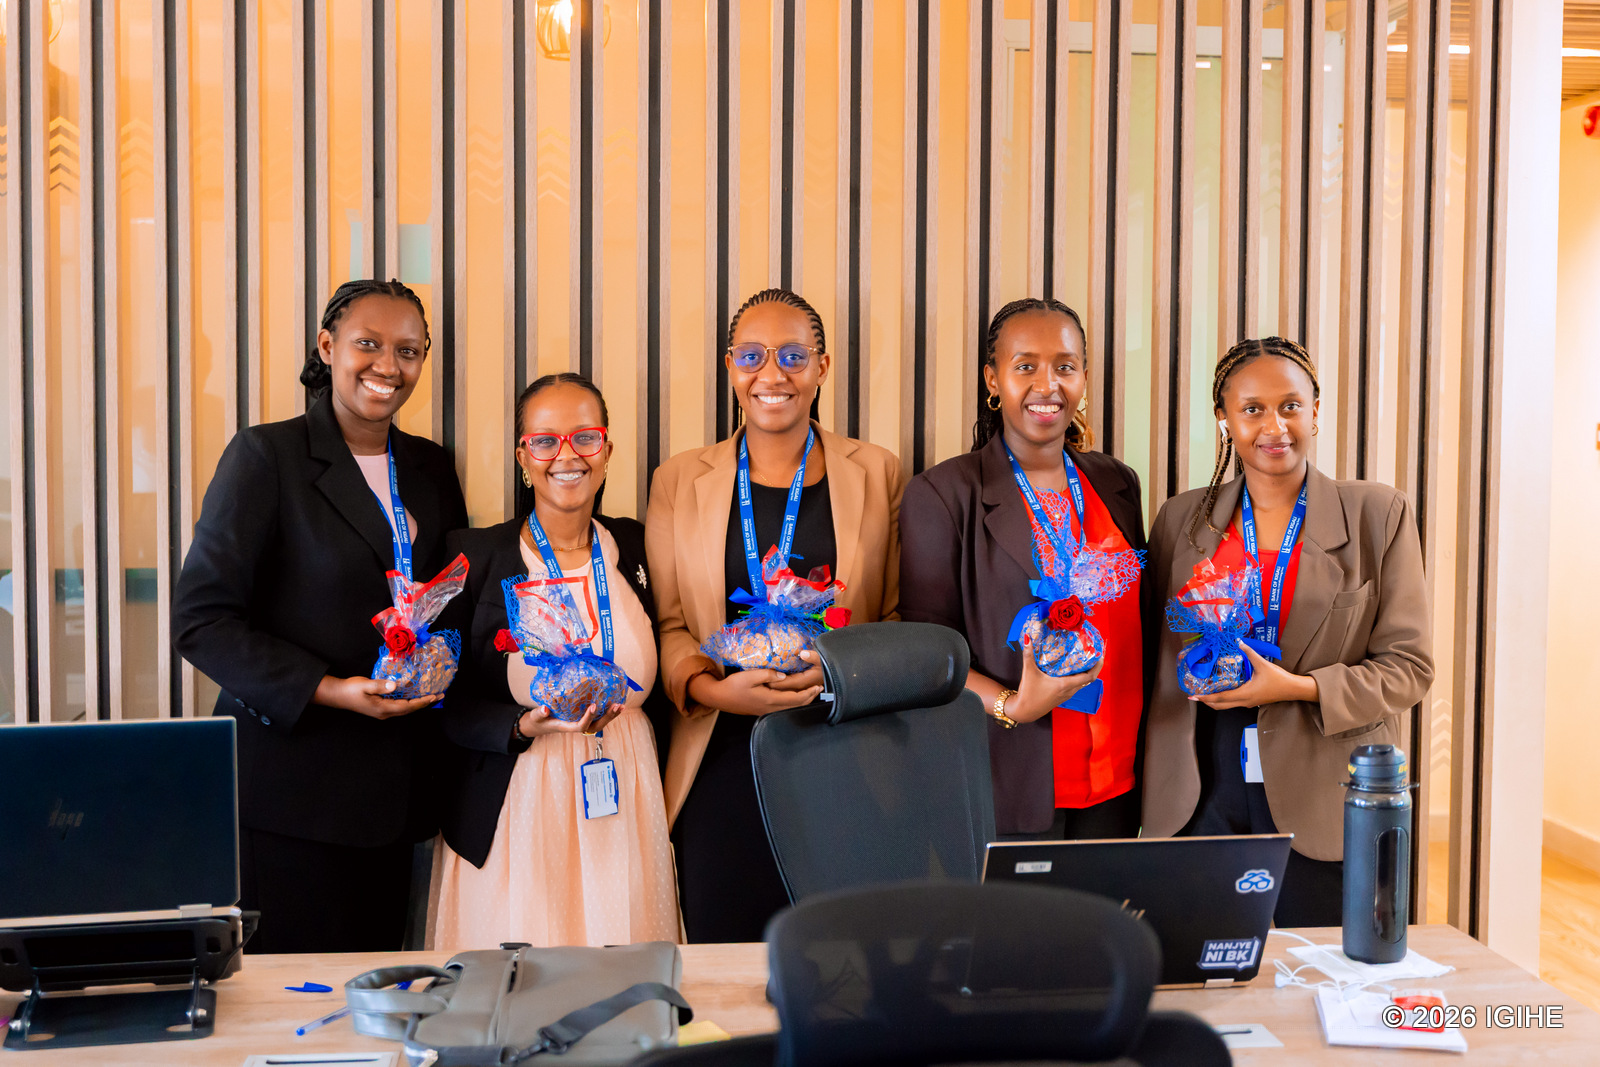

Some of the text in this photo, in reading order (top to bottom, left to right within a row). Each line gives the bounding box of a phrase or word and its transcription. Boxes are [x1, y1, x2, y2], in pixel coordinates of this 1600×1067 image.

[1015, 473, 1024, 486] KIGALI
[1025, 492, 1033, 503] BANK
[1289, 516, 1297, 529] KIGALI
[546, 559, 555, 574] KIGALI
[1208, 942, 1252, 950] NANJYE
[1205, 950, 1249, 962] NI BK
